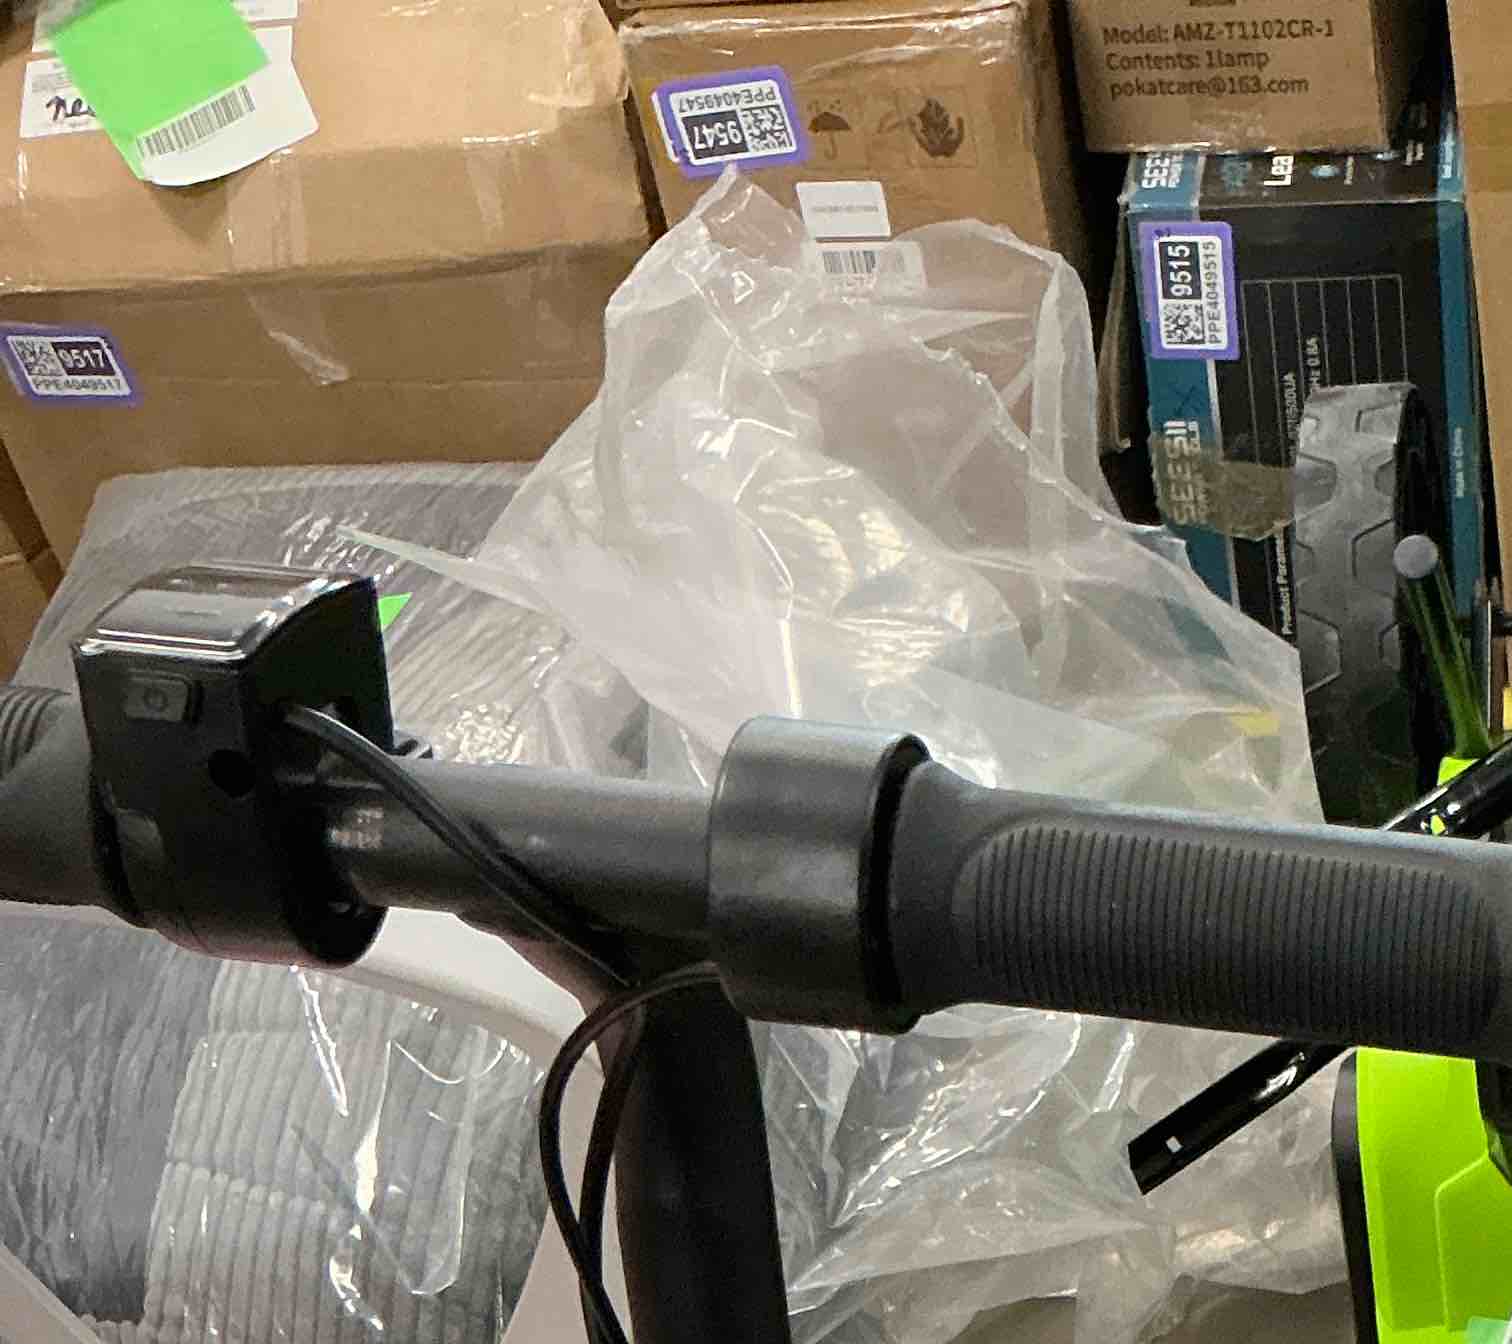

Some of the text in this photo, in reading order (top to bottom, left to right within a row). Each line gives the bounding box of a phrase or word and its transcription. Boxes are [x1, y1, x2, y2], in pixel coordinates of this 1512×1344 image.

[1103, 19, 1334, 45] Model: AMZ-T1102CR-1
[1106, 52, 1199, 71] Contents:
[678, 86, 777, 113] PPE4049547
[1111, 77, 1309, 101] pokatcare@163.com
[692, 120, 742, 150] 9547
[1168, 244, 1192, 297] 9515
[1202, 241, 1225, 345] PPE4049515
[59, 349, 105, 369] 9517
